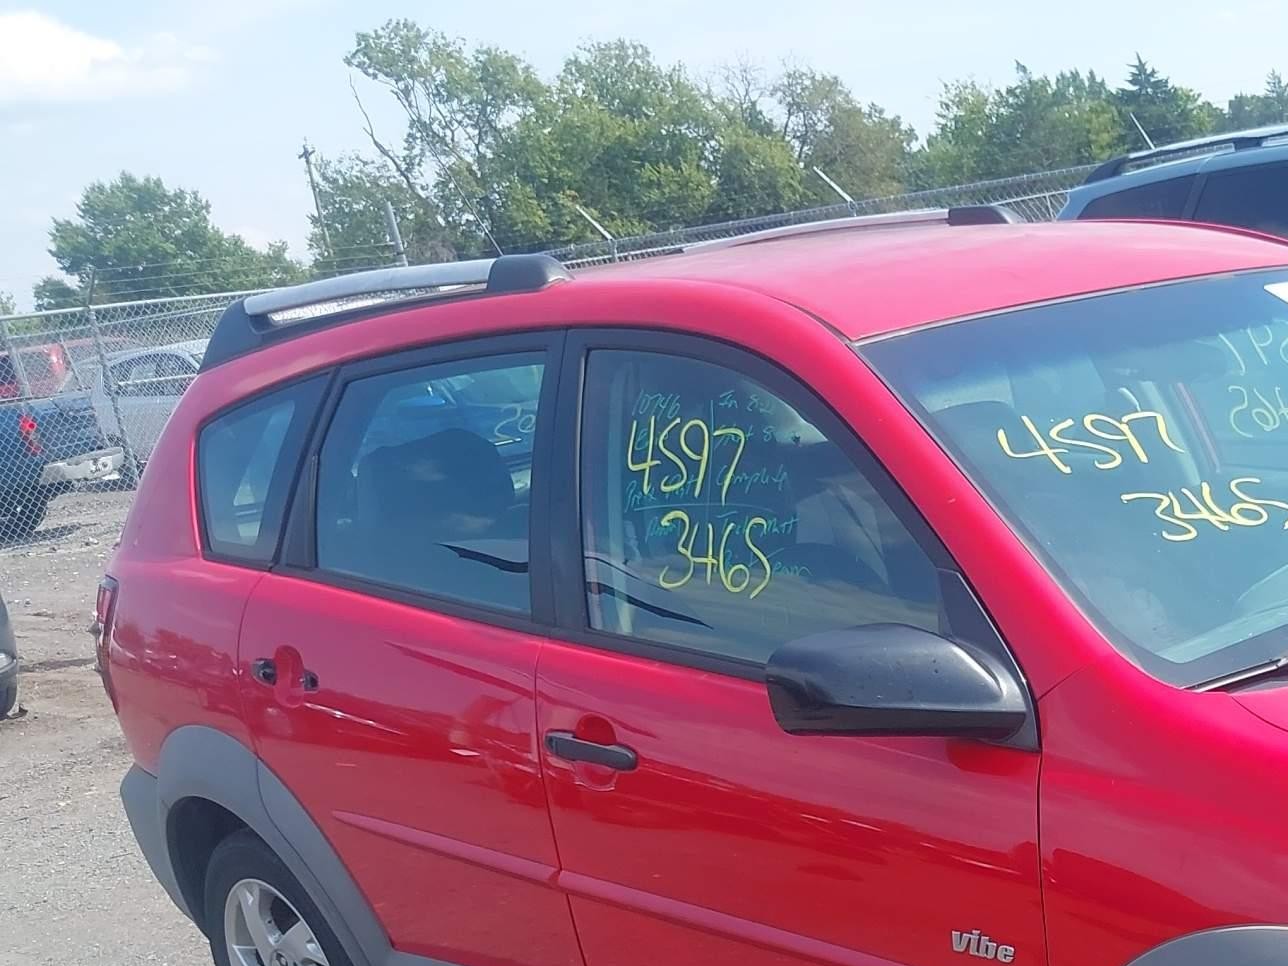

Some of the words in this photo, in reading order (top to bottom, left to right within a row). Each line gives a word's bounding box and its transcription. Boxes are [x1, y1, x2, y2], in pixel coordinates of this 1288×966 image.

[627, 415, 746, 507] 4597
[997, 408, 1185, 474] 4597
[659, 510, 772, 600] 3465
[951, 929, 1016, 964] Vibe
